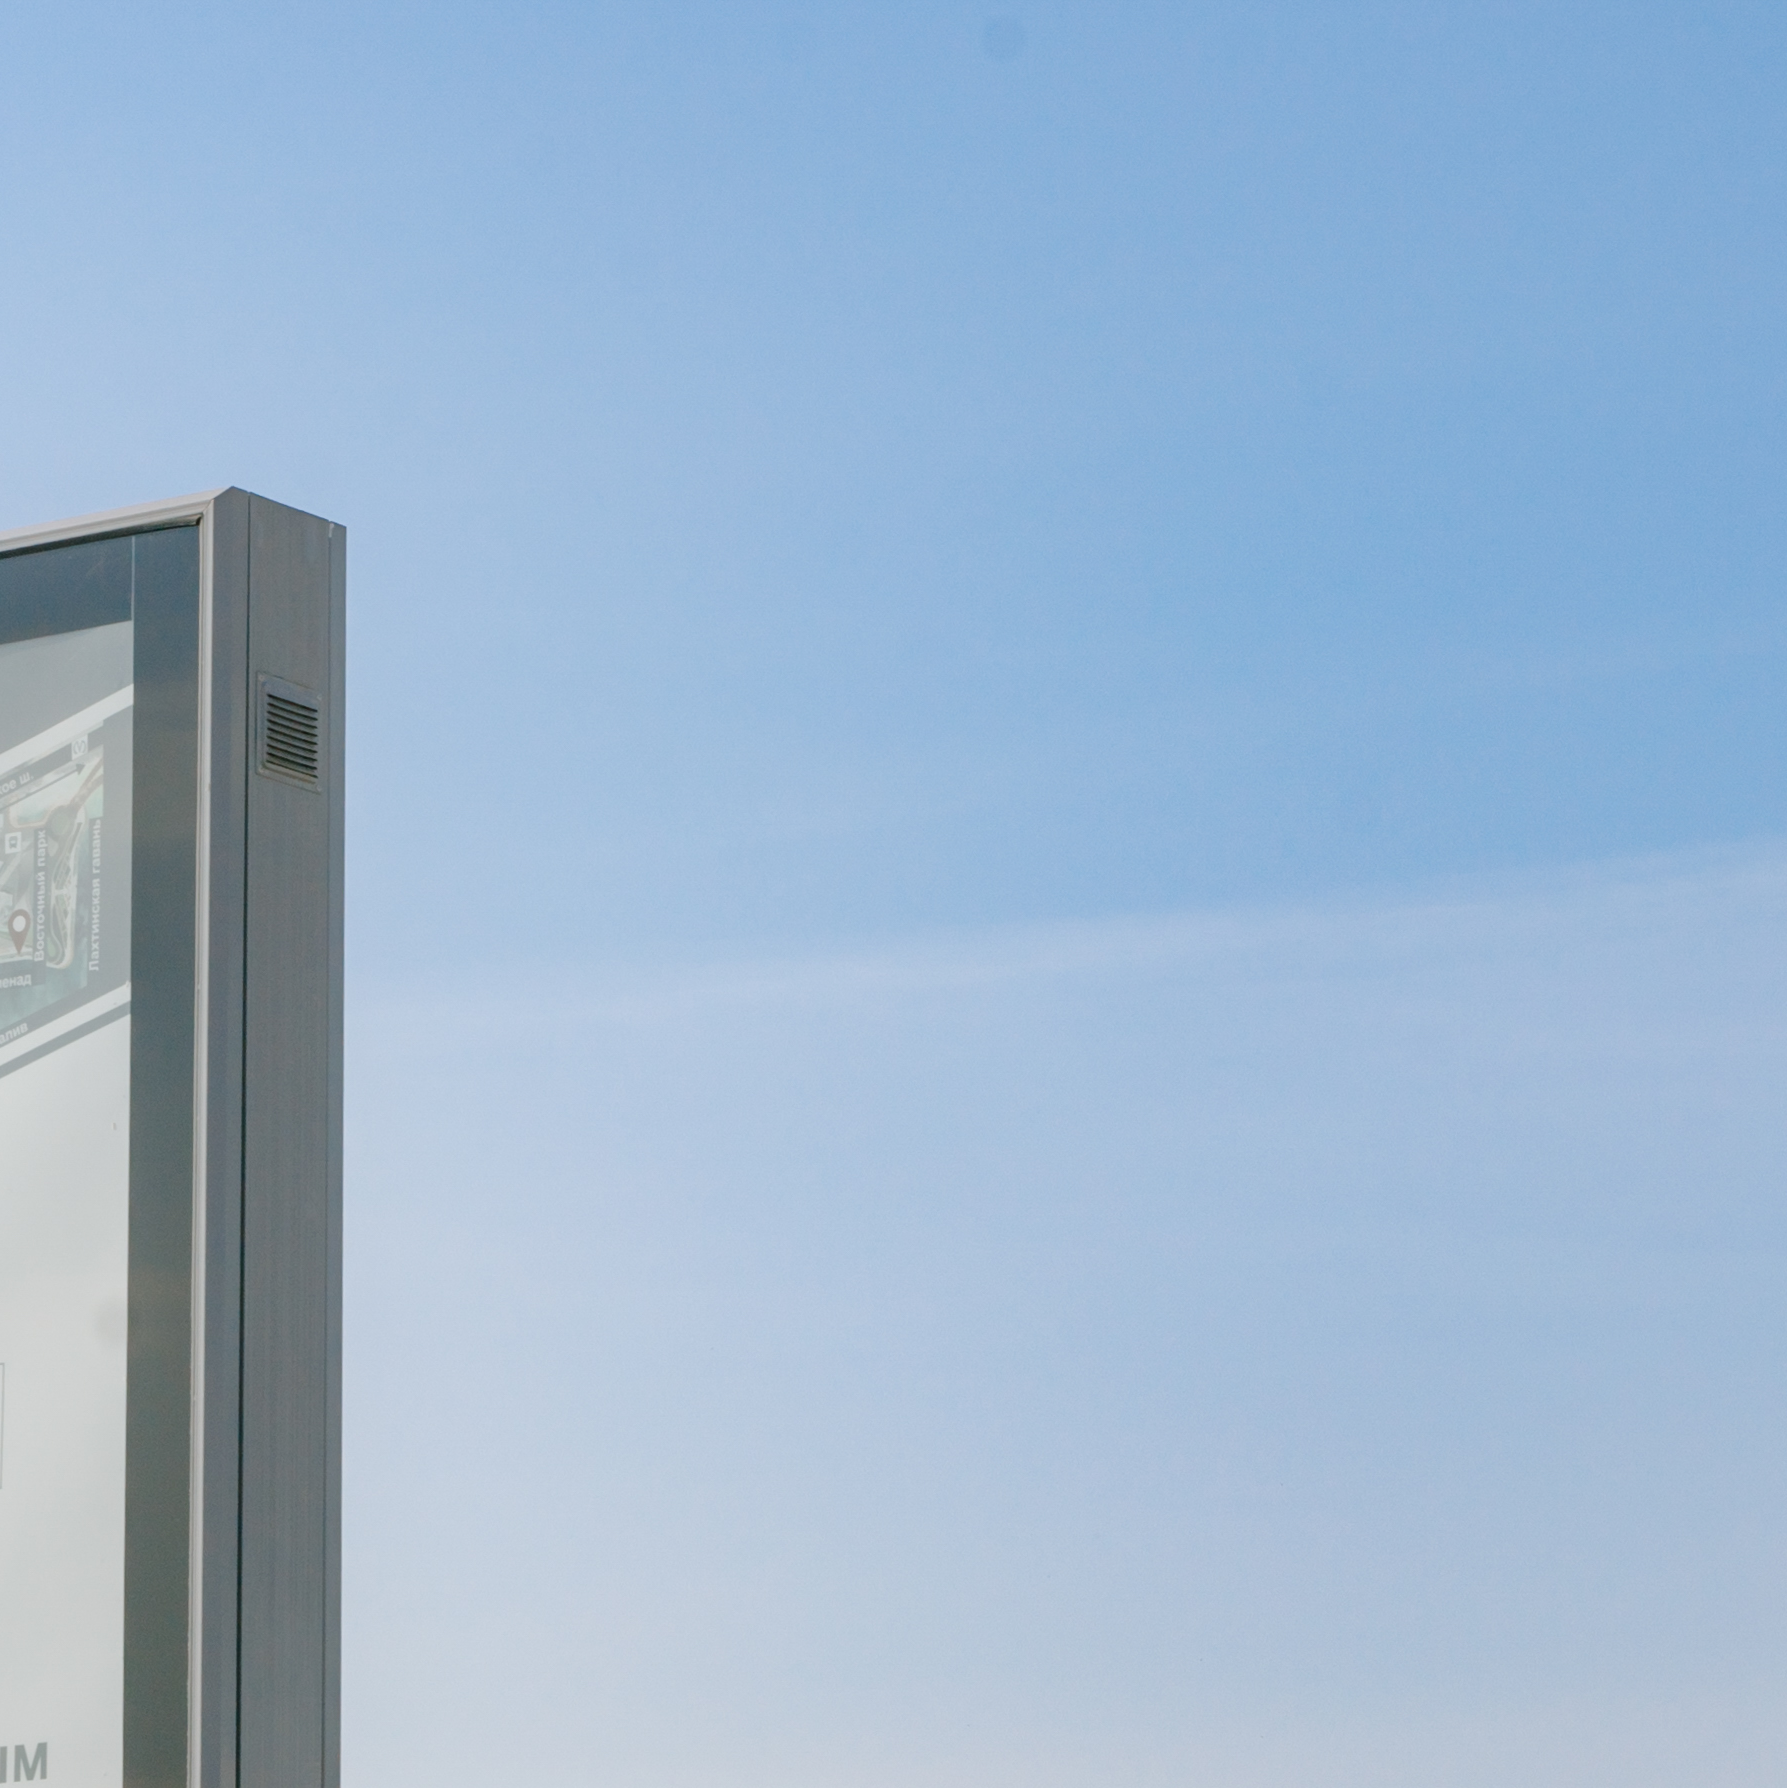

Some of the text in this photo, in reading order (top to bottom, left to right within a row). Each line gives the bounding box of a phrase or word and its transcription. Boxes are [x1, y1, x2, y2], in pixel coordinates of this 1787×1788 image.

[19, 771, 34, 785] ш.
[34, 829, 48, 962] Восточный парк
[89, 819, 102, 971] Лахтинская гавань
